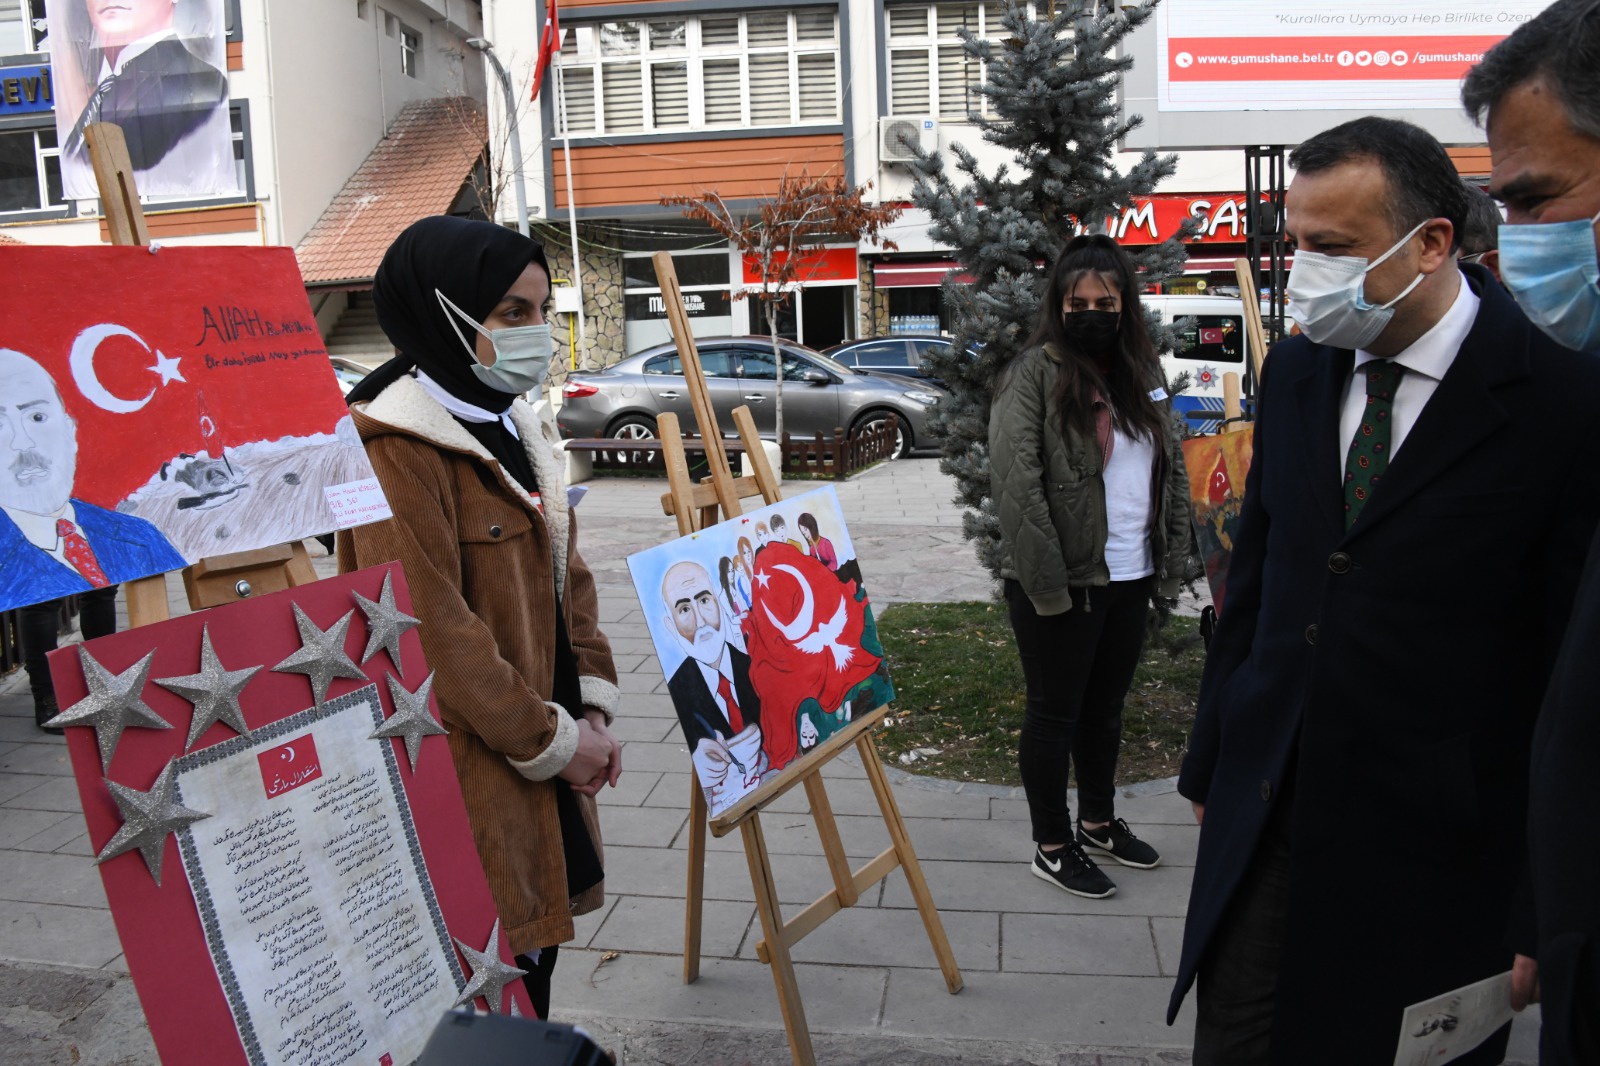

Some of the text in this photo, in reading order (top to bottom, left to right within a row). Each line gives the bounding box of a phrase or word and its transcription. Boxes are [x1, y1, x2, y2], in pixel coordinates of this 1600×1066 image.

[1349, 13, 1408, 25] Uymaya
[1412, 13, 1440, 24] Hep
[1444, 12, 1493, 23] Birlikte
[1497, 11, 1533, 22] Özen
[1197, 53, 1334, 65] www.gumushane.bel.tr
